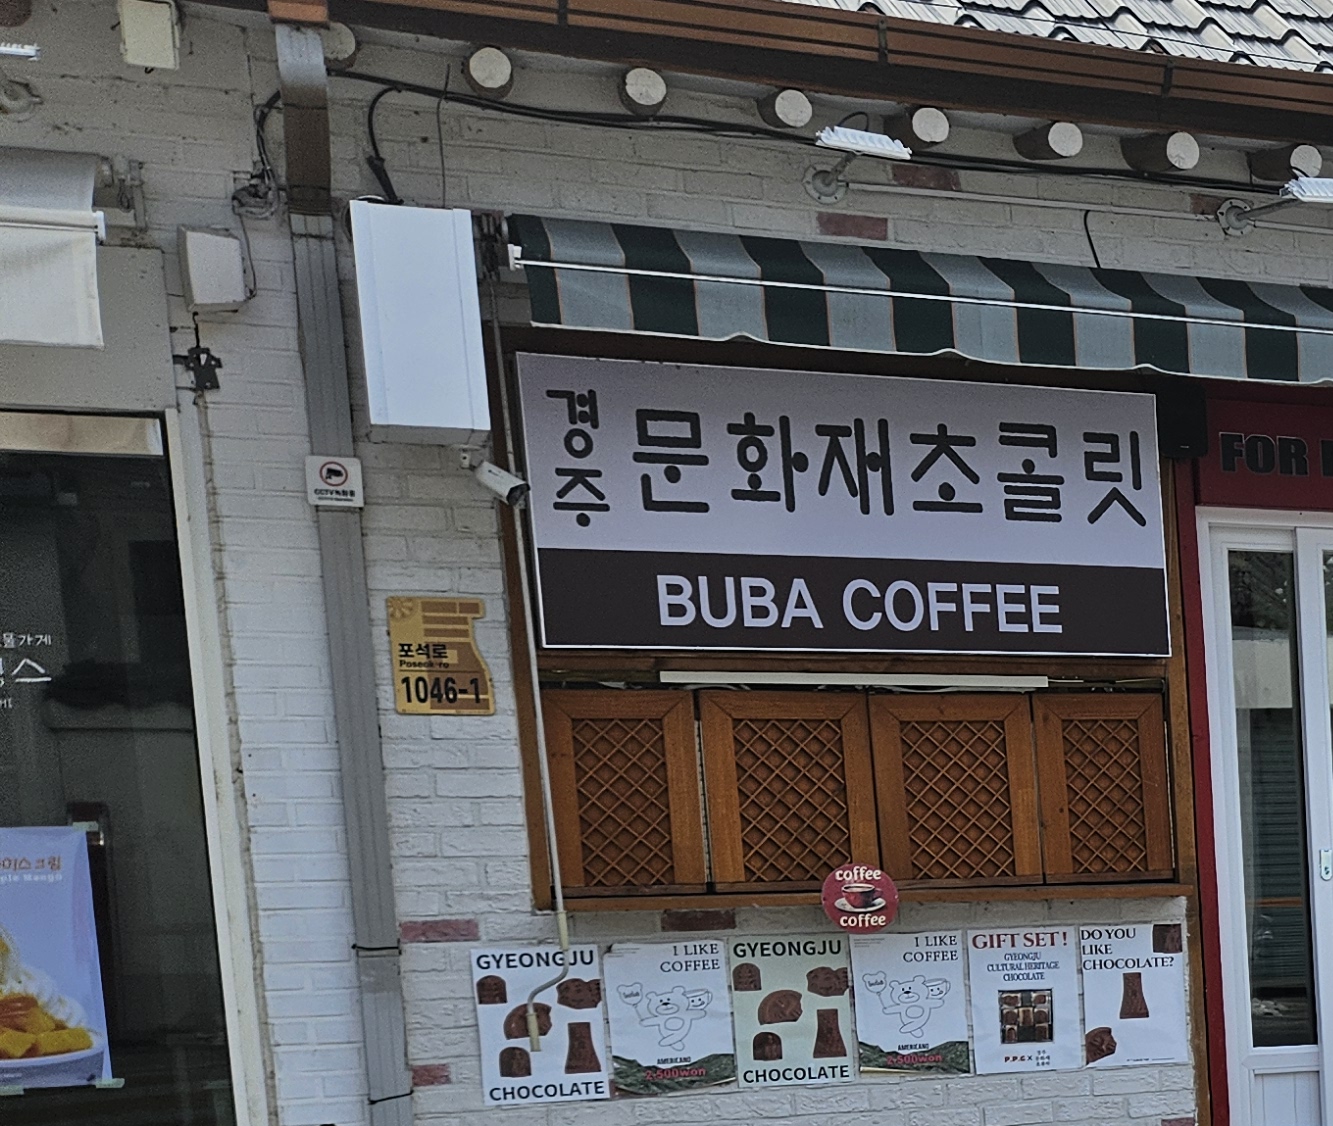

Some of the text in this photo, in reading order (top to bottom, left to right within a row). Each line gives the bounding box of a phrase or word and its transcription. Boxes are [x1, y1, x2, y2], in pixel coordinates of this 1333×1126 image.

[545, 387, 1147, 527] 경주 문화재초콜릿
[1218, 431, 1309, 476] FOR
[656, 574, 1064, 635] BUBA COFFEE
[0, 632, 52, 648] 물가게
[398, 643, 449, 659] 포석로
[401, 676, 481, 704] 1046-1
[835, 866, 882, 881] coffee
[839, 913, 887, 927] coffee
[915, 935, 958, 947] I LIKE
[971, 933, 1019, 950] GIFT
[1080, 928, 1137, 941] DO YOU
[673, 943, 720, 956] I LIKE
[733, 939, 842, 959] GYEONGJU
[903, 950, 959, 963] COFFEE
[1003, 952, 1042, 961] GYEONGJU
[1081, 944, 1113, 956] LIKE
[475, 949, 595, 971] GYEONGJU
[660, 959, 721, 973] COFFEE
[986, 961, 1060, 973] CULTURAL HERITAGE
[1082, 956, 1175, 971] CHOCOLATE?
[1003, 972, 1046, 982] CHOCOLATE
[743, 1065, 850, 1084] CHOCOLATE
[489, 1080, 605, 1101] CHOCOLATE
